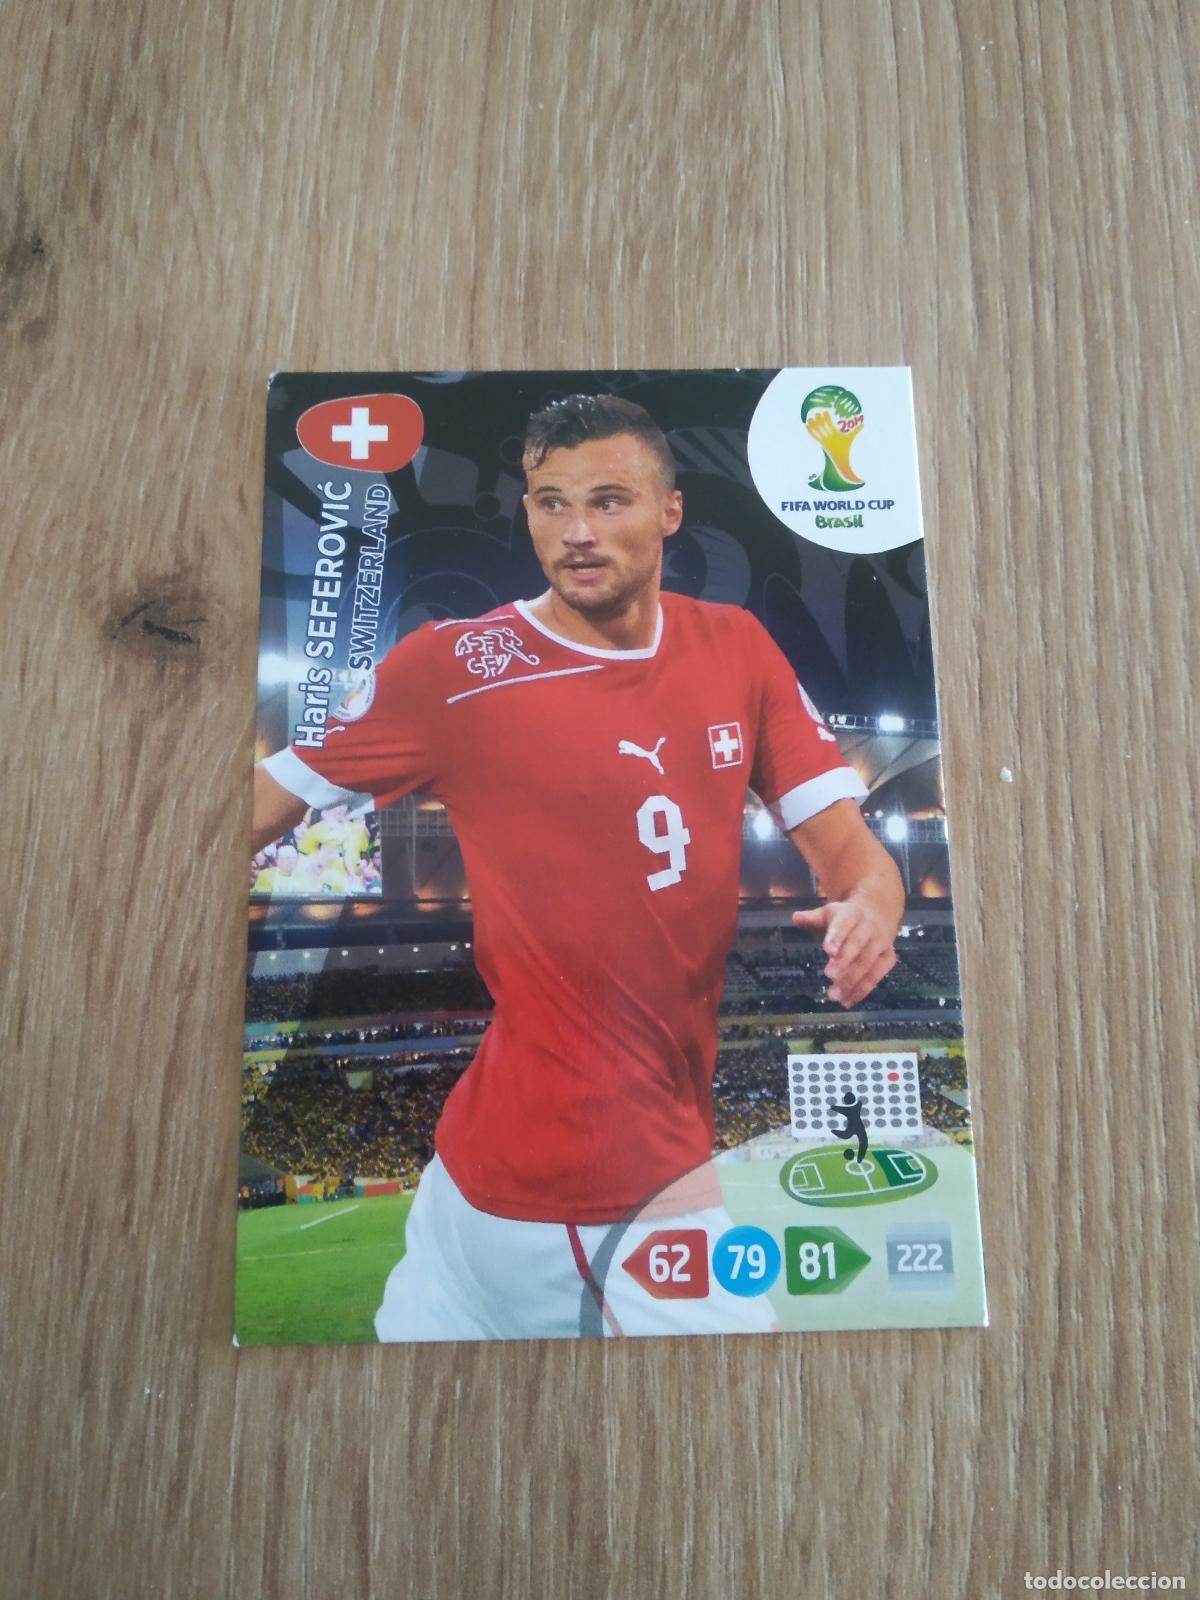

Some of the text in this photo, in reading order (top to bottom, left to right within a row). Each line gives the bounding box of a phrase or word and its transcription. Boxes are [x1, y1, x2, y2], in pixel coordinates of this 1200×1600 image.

[781, 499, 895, 512] FIFA WORLD CUP
[815, 514, 864, 529] Brasil
[348, 484, 391, 672] SWITZERLAND
[293, 480, 352, 749] Haris SEFEROVIĆ
[636, 795, 691, 892] 9
[649, 1244, 691, 1283] 62
[727, 1245, 766, 1280] 79
[799, 1241, 837, 1280] 81
[896, 1243, 944, 1273] 222
